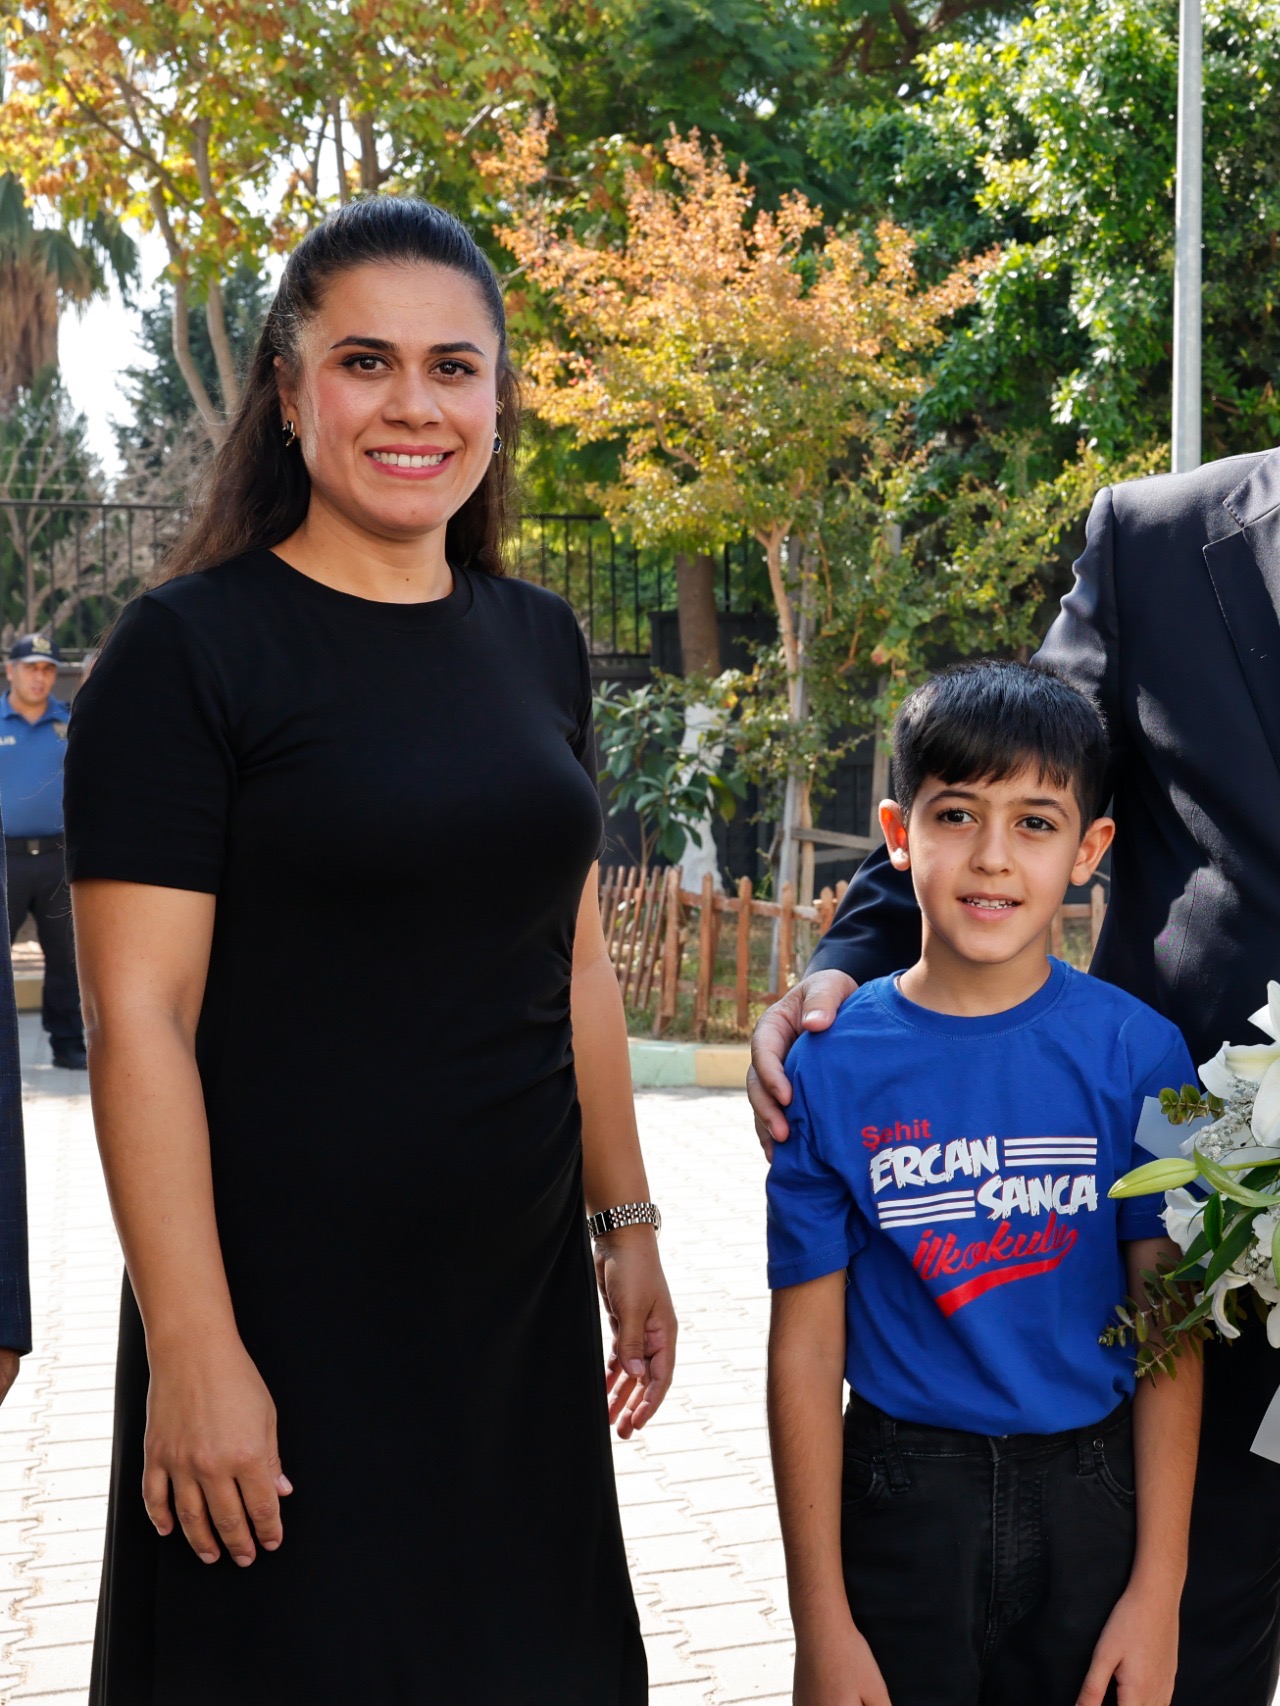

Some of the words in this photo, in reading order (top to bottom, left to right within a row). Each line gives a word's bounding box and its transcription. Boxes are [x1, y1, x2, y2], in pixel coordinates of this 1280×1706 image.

[861, 1119, 931, 1150] Şehit
[870, 1136, 999, 1194] ERCAN
[977, 1174, 1099, 1221] SANCA
